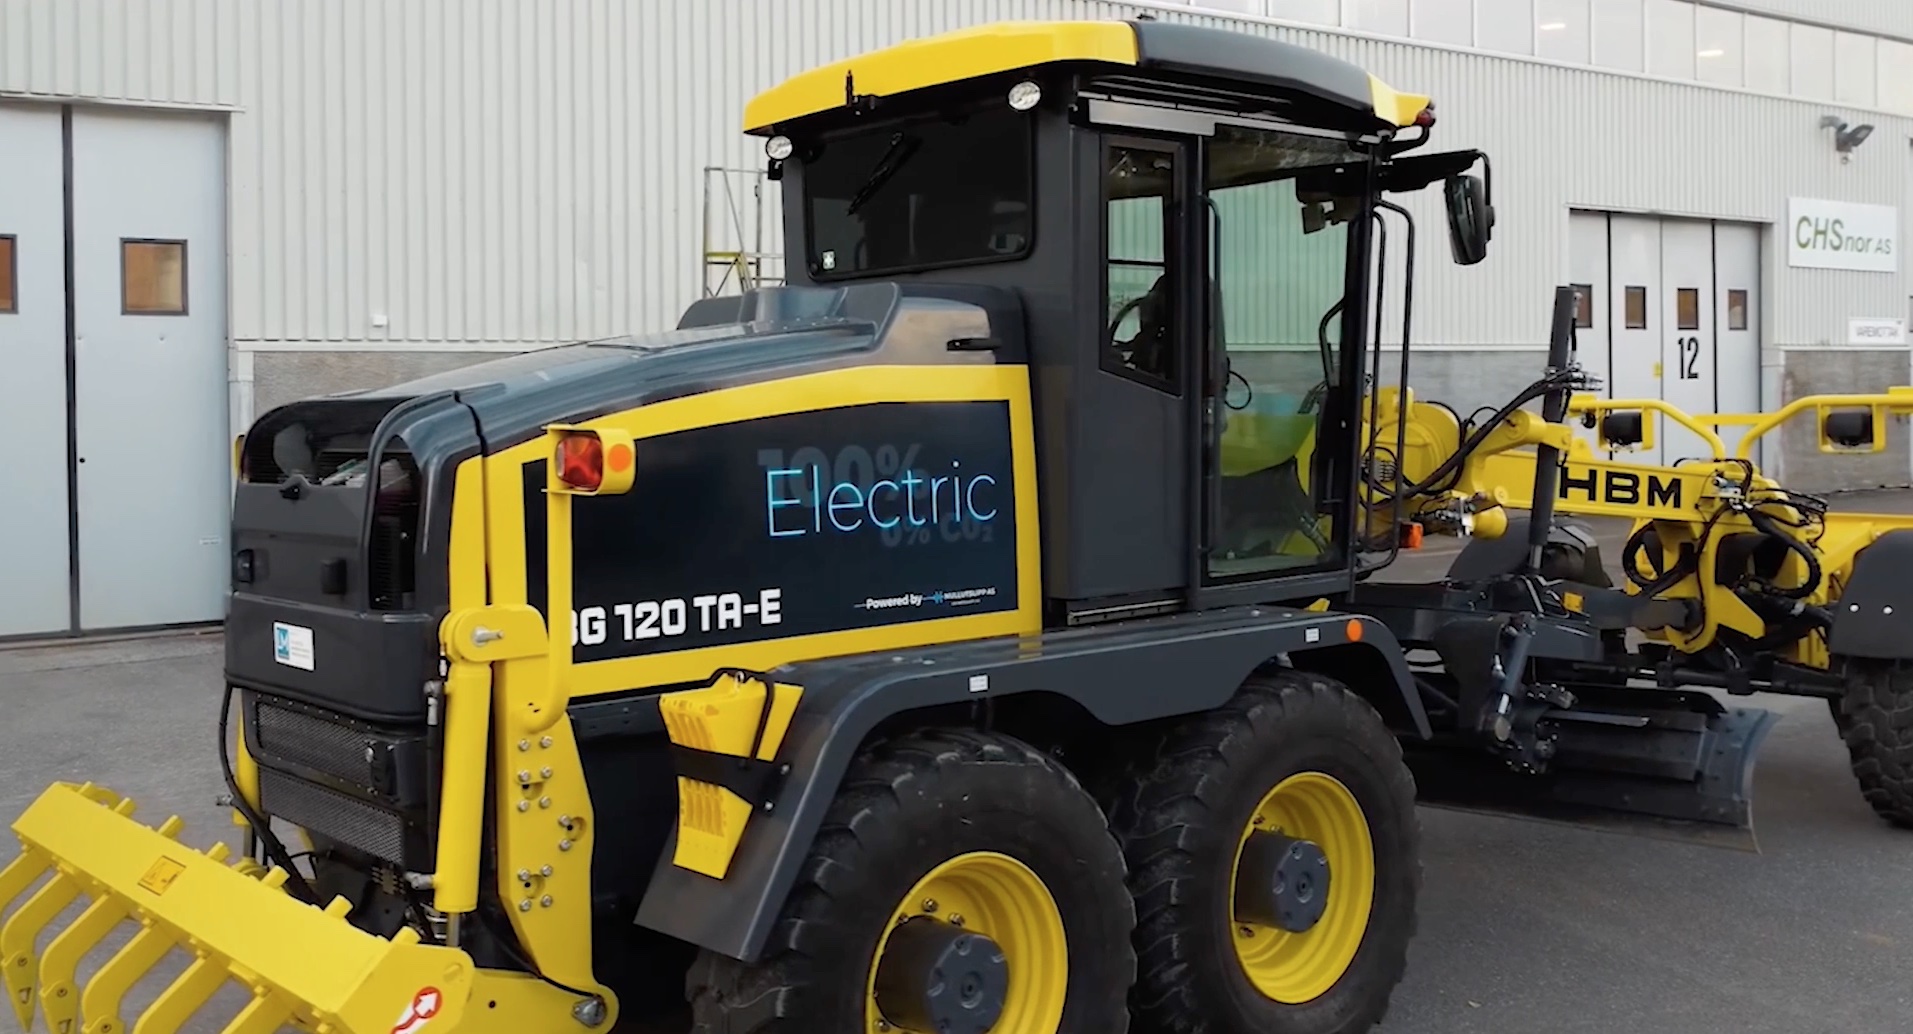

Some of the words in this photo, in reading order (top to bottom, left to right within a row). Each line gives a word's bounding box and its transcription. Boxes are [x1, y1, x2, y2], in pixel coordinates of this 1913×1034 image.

[1796, 215, 1873, 253] CHSnor
[1874, 238, 1892, 255] AS
[1677, 336, 1699, 379] 12
[766, 461, 998, 538] Electric
[1559, 466, 1682, 508] HBM
[614, 598, 686, 641] 120
[693, 588, 782, 632] TA-E
[866, 594, 909, 609] Powered
[910, 594, 922, 606] by
